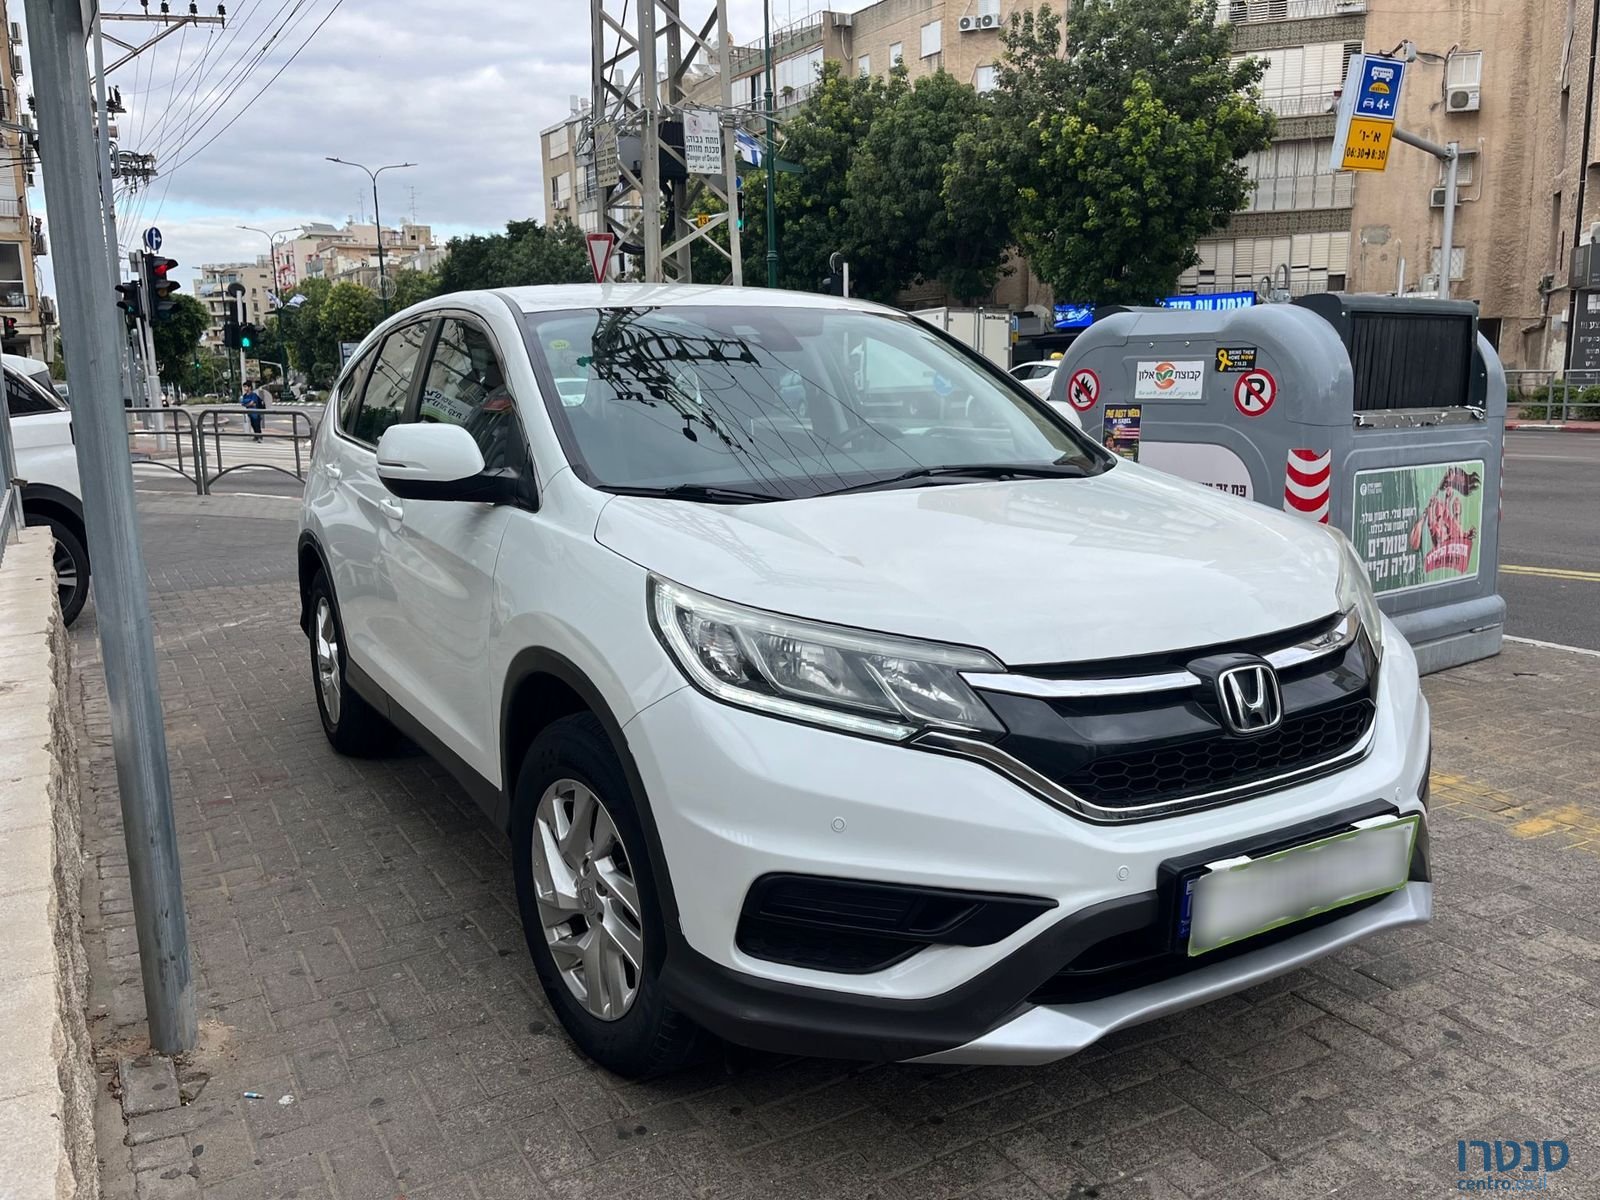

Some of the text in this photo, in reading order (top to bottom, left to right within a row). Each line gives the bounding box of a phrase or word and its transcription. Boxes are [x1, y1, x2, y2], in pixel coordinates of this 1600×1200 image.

[705, 136, 719, 145] מתח
[704, 146, 720, 154] סכנת
[1346, 147, 1386, 160] 06:30 8:30
[699, 216, 707, 225] 13
[1138, 370, 1202, 381] קבוצת אלון
[1231, 484, 1247, 498] פח
[1368, 534, 1408, 557] שומרים
[1391, 553, 1416, 577] עליה
